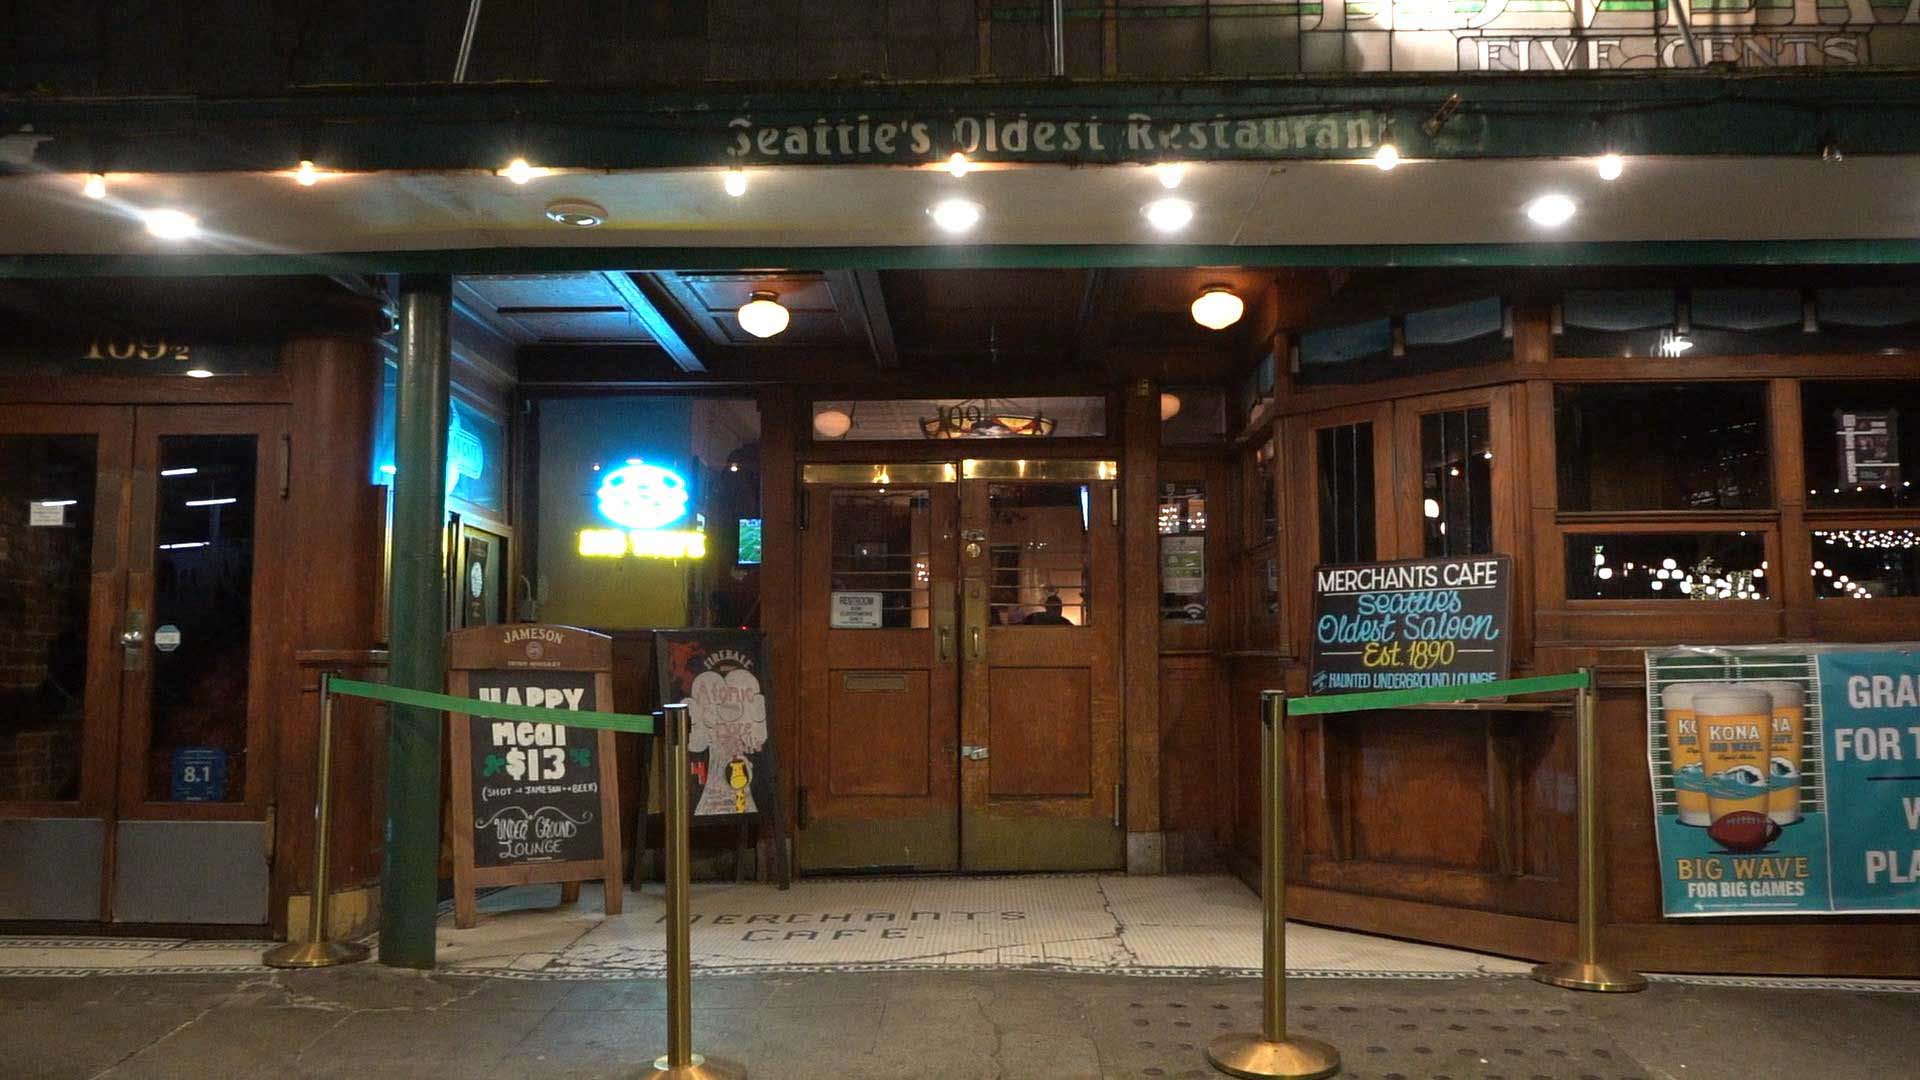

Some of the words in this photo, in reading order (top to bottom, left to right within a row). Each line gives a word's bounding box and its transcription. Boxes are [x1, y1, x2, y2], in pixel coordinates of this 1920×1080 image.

[1477, 39, 1621, 71] FIVE
[727, 114, 931, 156] Seattle's
[952, 112, 1105, 153] Oldest
[1317, 564, 1438, 593] MERCHANTS
[1443, 560, 1498, 587] CAFE
[1358, 589, 1463, 616] Seattle's
[503, 627, 564, 645] JAMESON
[1317, 613, 1397, 644] Oldest
[1403, 612, 1500, 641] Saloon
[1409, 639, 1456, 671] 1890
[1328, 672, 1371, 689] HAUNTED
[1373, 671, 1449, 689] UNDERGROUND
[1848, 674, 1920, 709] GRA
[1709, 725, 1760, 741] KONA
[1834, 727, 1903, 761] FOR
[184, 766, 210, 784] 8.1
[505, 747, 566, 781] $13
[1677, 858, 1724, 881] BIG
[1732, 856, 1809, 880] WAVE
[1688, 882, 1718, 898] FOR
[1721, 881, 1748, 898] BIG
[1750, 881, 1806, 897] GAMES
